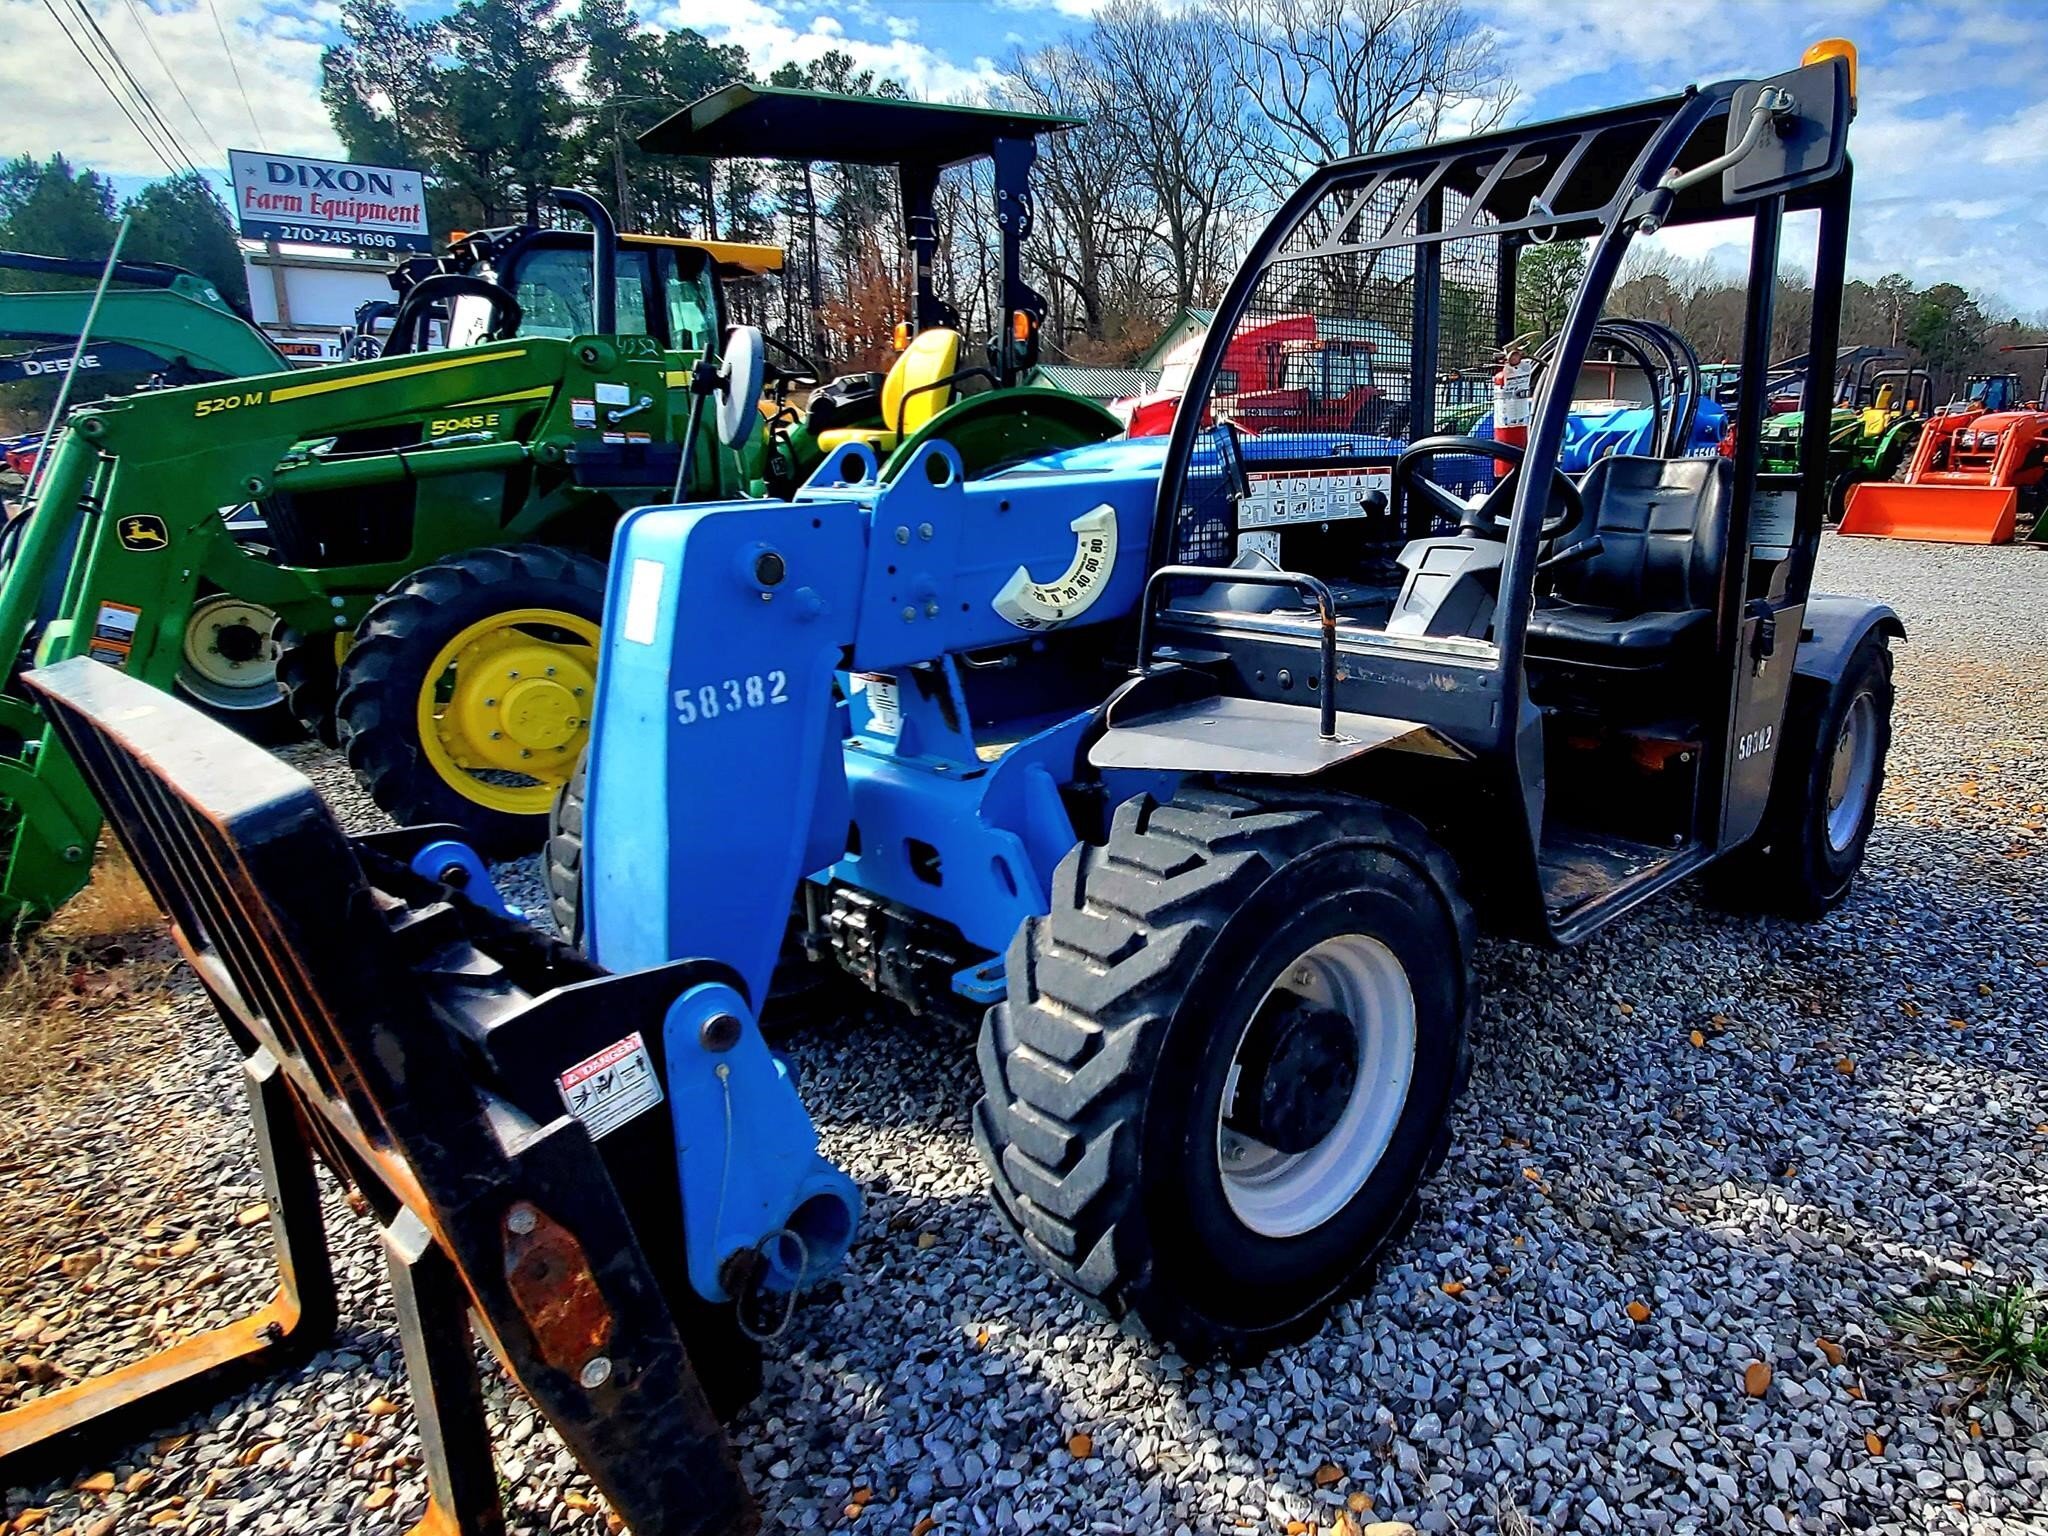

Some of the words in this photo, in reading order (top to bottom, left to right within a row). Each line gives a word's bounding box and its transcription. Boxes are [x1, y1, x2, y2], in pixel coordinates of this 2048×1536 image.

[266, 162, 394, 197] DIXON
[246, 186, 302, 212] Farm
[311, 192, 420, 224] Equipment
[280, 226, 396, 248] 270-245-1696
[195, 396, 241, 417] 520
[243, 392, 263, 406] M
[431, 416, 484, 435] 5045
[486, 414, 500, 426] E
[1090, 538, 1103, 553] 80
[1085, 558, 1100, 573] 60
[1077, 575, 1091, 588] 40
[1063, 587, 1078, 600] 20
[674, 670, 788, 724] 58382
